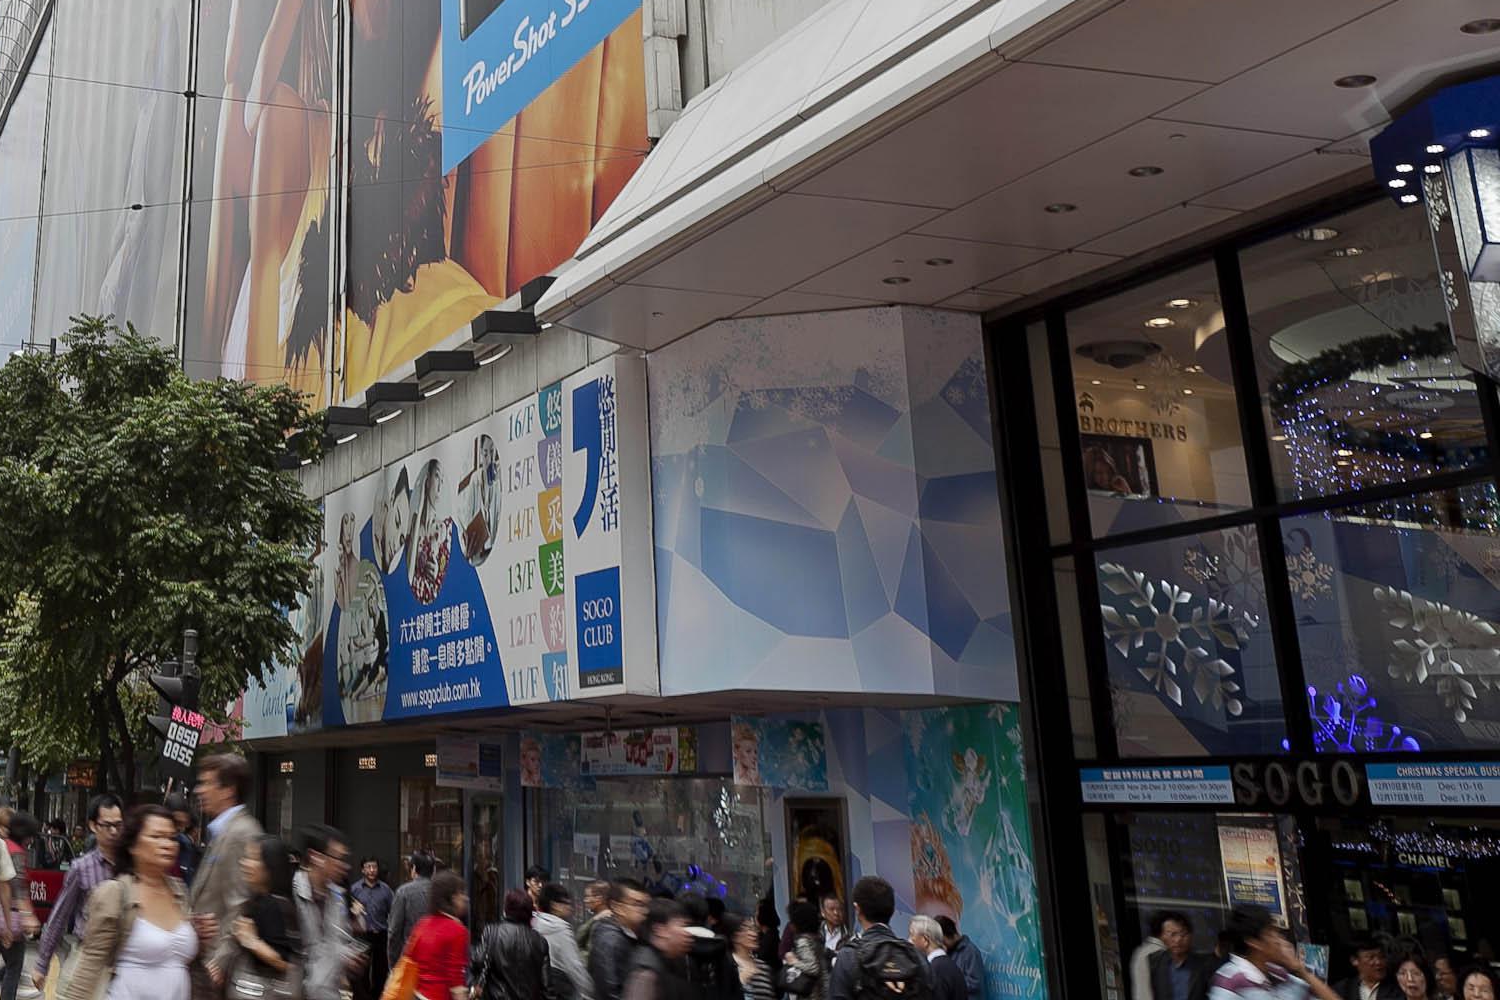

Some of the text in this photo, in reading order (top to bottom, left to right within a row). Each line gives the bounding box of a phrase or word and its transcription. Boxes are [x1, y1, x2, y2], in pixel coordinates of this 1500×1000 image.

[462, 15, 556, 118] PowerShot
[508, 403, 535, 443] 16/F
[1080, 415, 1188, 442] BROTHERS
[508, 455, 535, 495] 15/F
[508, 506, 535, 544] 14/F
[508, 558, 535, 596] 13/F
[548, 549, 563, 590] 美
[583, 597, 613, 622] SOGO
[509, 612, 537, 648] 12/F
[584, 624, 613, 648] CLUB
[401, 677, 482, 709] www.sogoclub.com.hk
[511, 666, 539, 701] 11/F
[167, 721, 199, 749] 0858
[163, 739, 194, 767] 0855
[1233, 760, 1360, 807] SOGO
[1397, 766, 1442, 777] CHRISTMAS
[1444, 767, 1478, 777] SPECIAL
[1398, 853, 1453, 868] CHANEL
